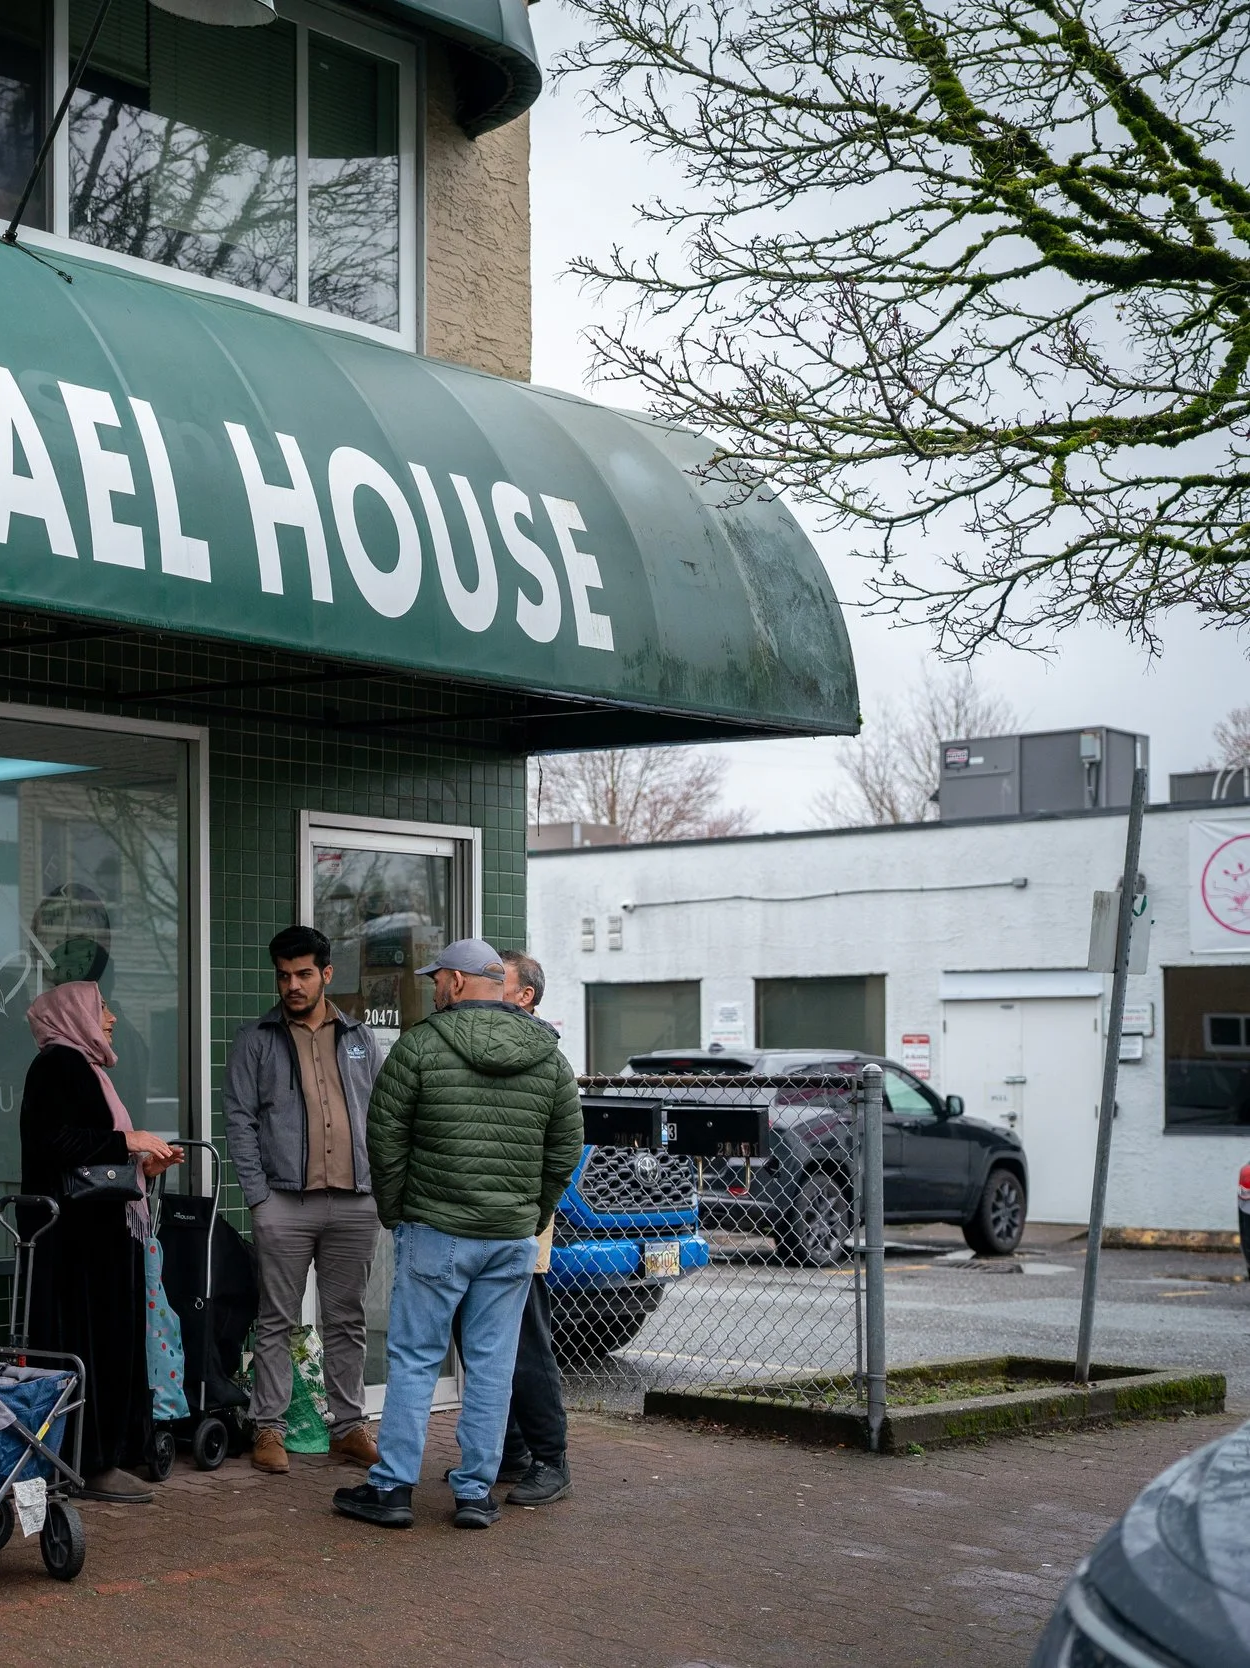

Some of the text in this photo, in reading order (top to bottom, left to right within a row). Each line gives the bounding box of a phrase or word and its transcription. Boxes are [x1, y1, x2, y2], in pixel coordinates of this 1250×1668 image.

[223, 420, 614, 652] HOUSE
[364, 1009, 400, 1026] 20471
[668, 1123, 676, 1140] 3
